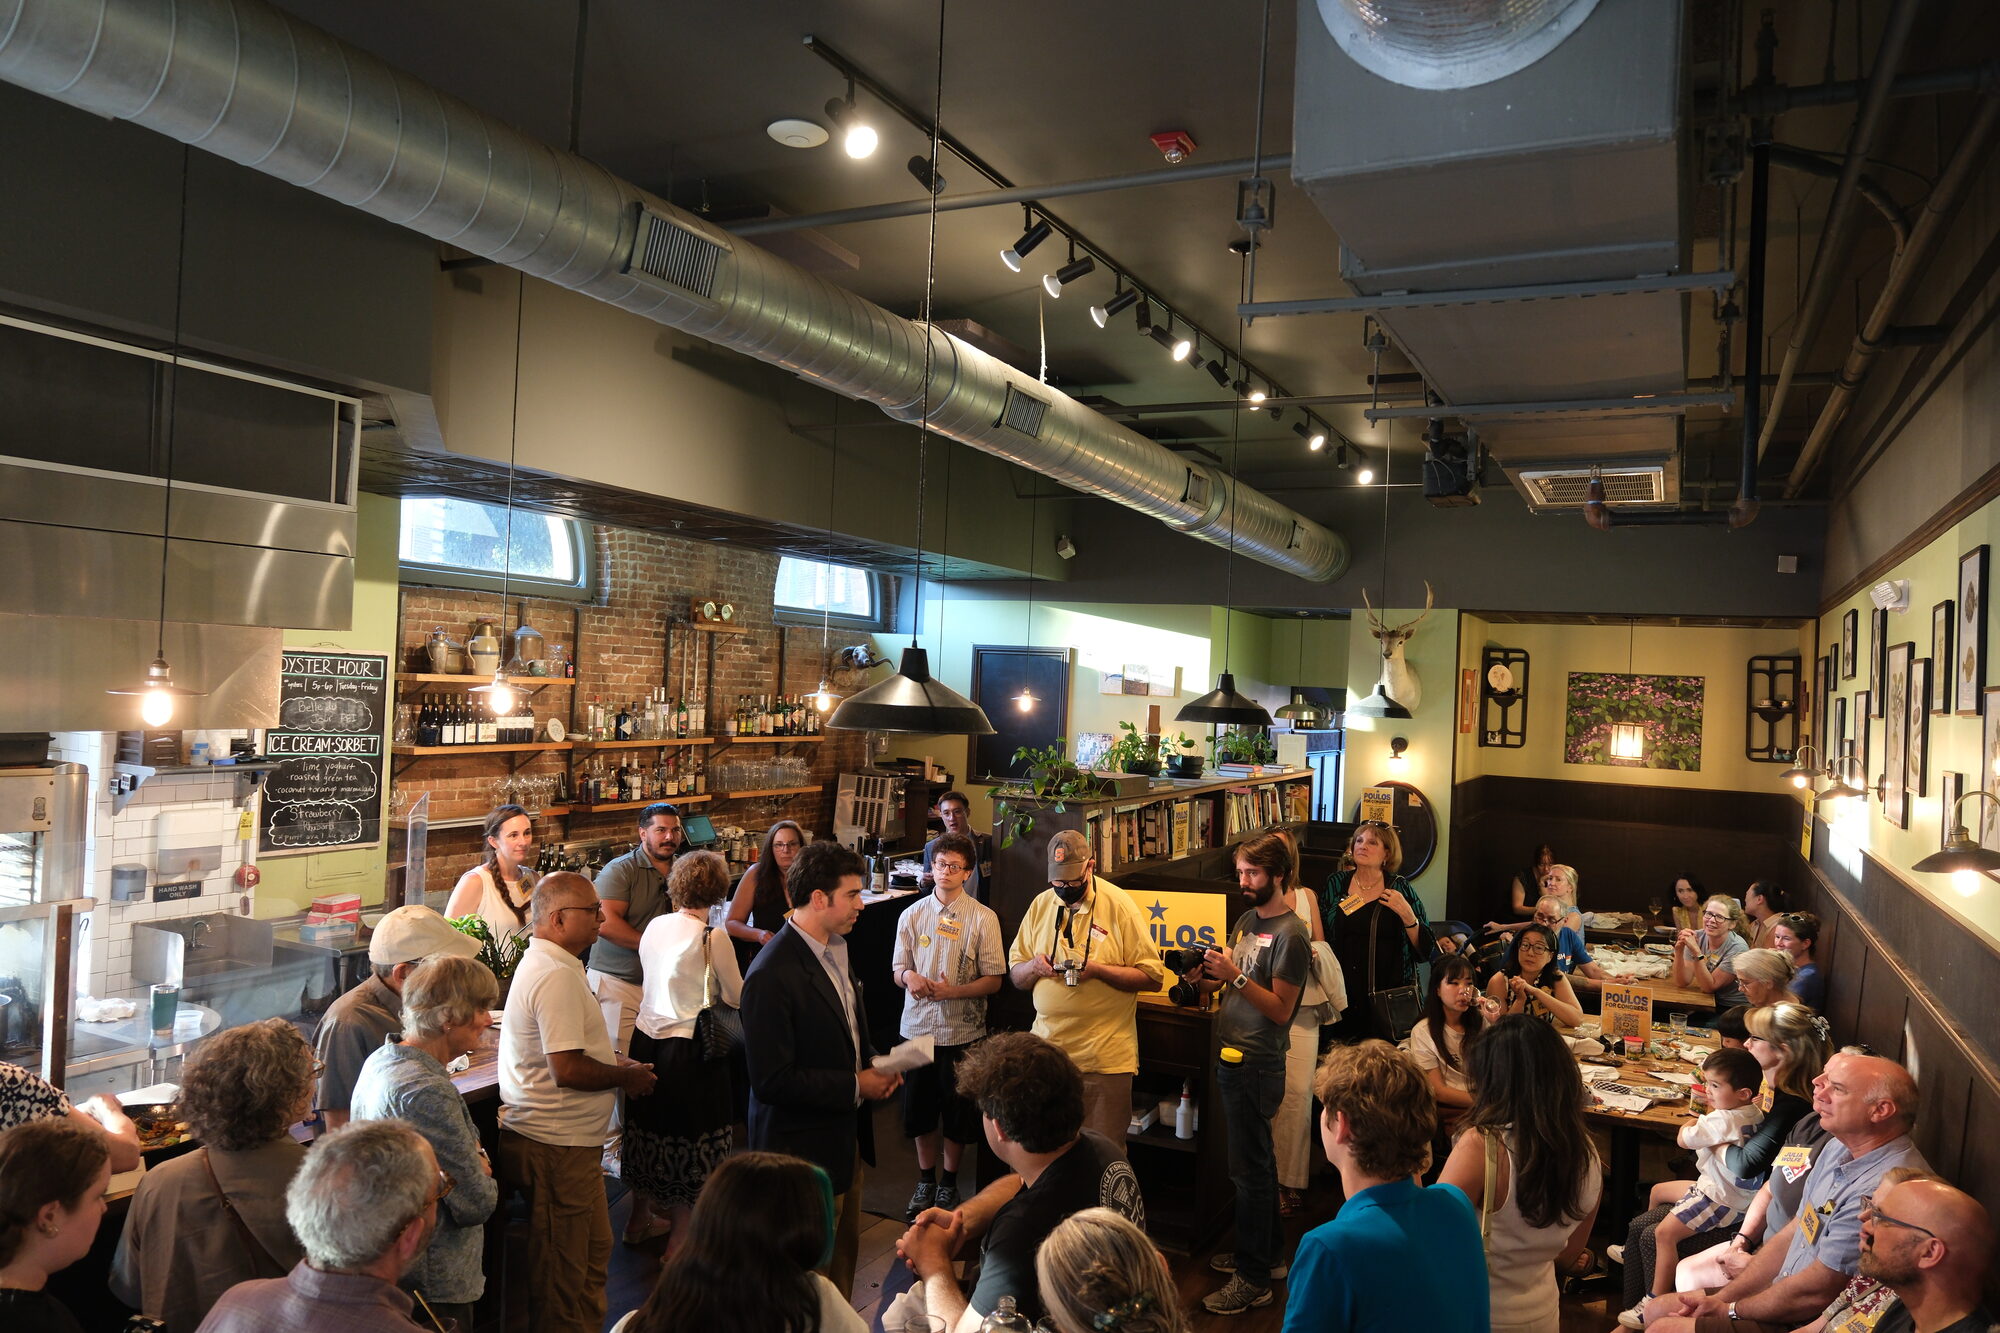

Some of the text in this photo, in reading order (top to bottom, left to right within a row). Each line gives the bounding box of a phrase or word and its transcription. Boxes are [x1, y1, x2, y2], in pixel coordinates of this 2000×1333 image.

[281, 657, 373, 676] OYSTER HOUR
[269, 736, 290, 752] ICE
[292, 736, 331, 752] CREAM
[302, 762, 320, 771] lime
[323, 775, 342, 785] green
[1364, 793, 1391, 801] POULOS
[289, 807, 344, 821] Strawberry
[158, 886, 178, 894] HAND
[1605, 992, 1648, 1006] POULOS
[1617, 1003, 1649, 1012] CONGRESS
